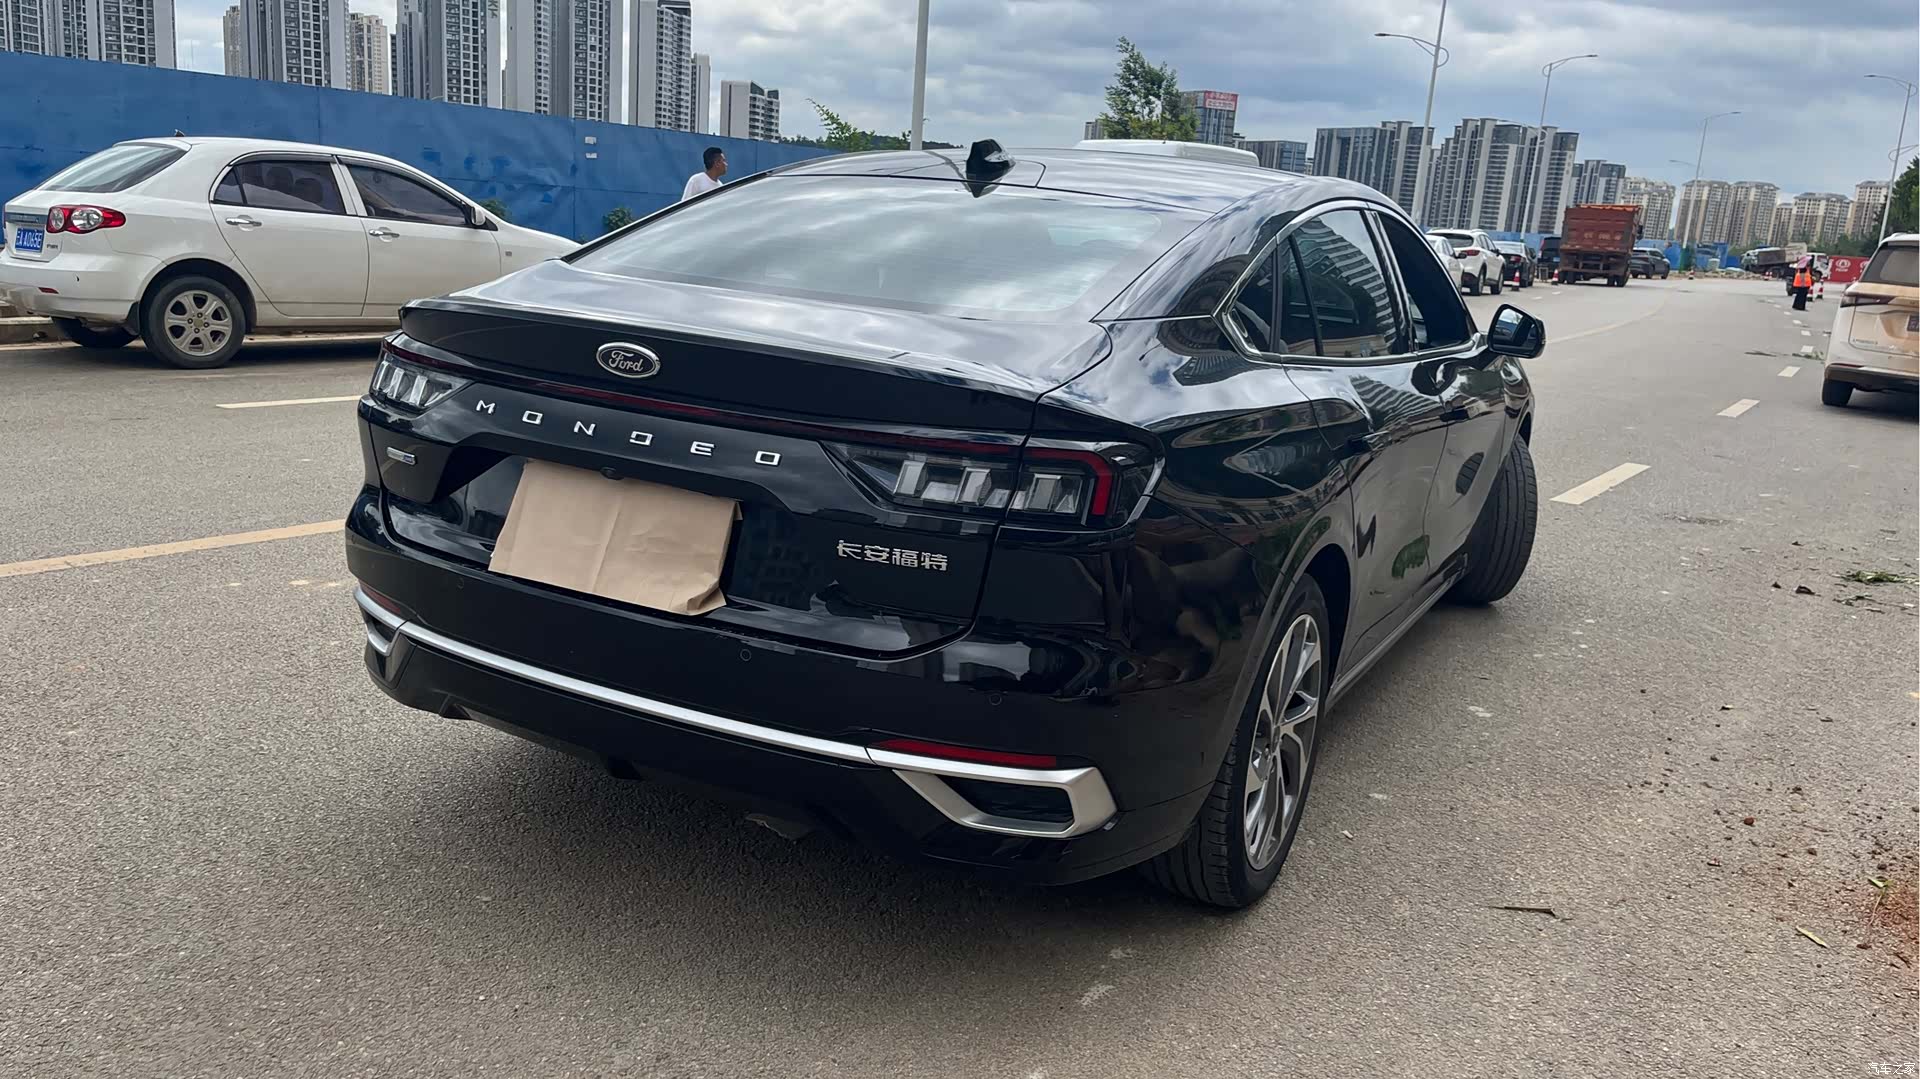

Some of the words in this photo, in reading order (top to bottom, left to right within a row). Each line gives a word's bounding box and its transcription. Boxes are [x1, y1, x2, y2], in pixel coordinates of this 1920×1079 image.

[608, 350, 643, 371] Ford
[476, 400, 781, 466] MONDEO
[837, 540, 947, 571] 长安福特
